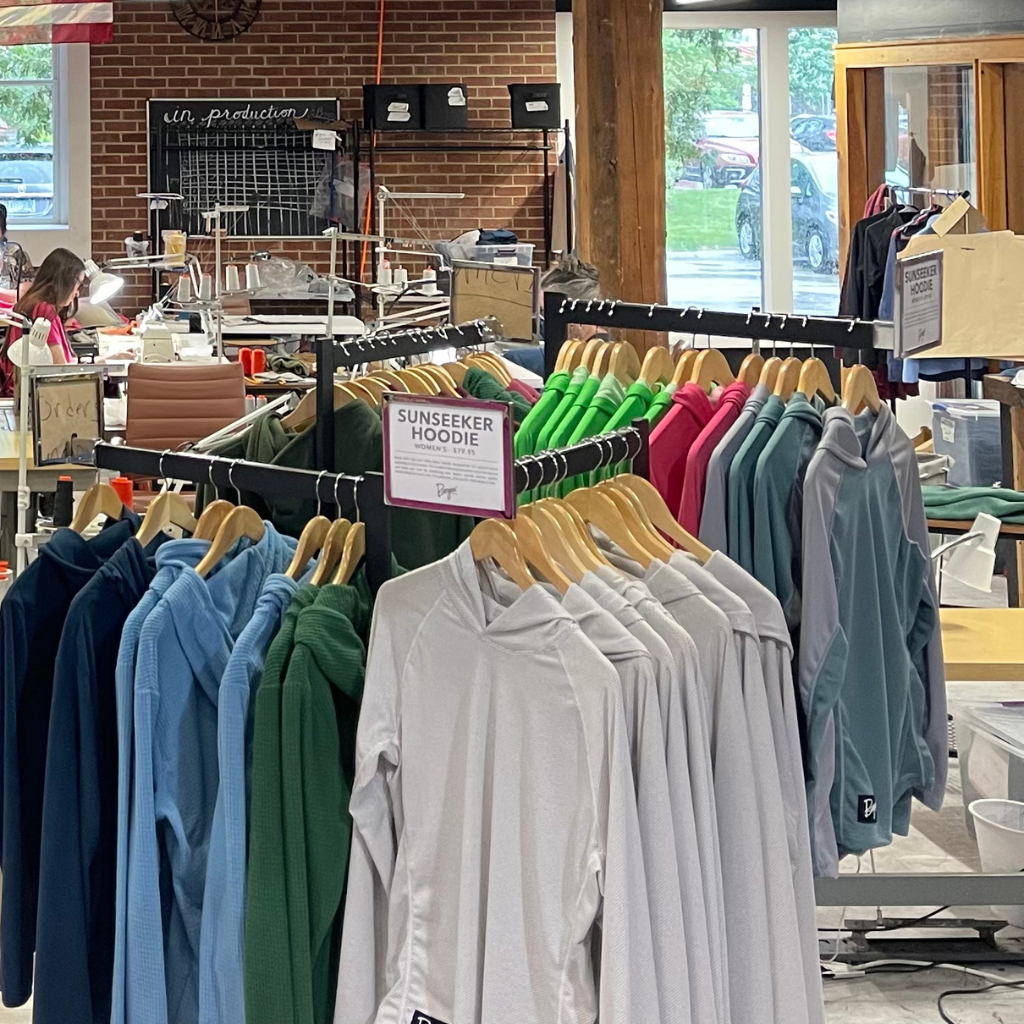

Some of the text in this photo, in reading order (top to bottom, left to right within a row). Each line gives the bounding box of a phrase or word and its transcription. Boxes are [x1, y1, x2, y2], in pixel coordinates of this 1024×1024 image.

[164, 105, 195, 123] in
[201, 104, 309, 128] production
[905, 265, 937, 283] SUNSEEKER
[910, 279, 933, 296] HOODIE
[398, 409, 494, 432] SUNSEEKER
[412, 426, 479, 447] HOODIE
[414, 443, 447, 452] WOMEN'S
[453, 447, 476, 456] $79.95
